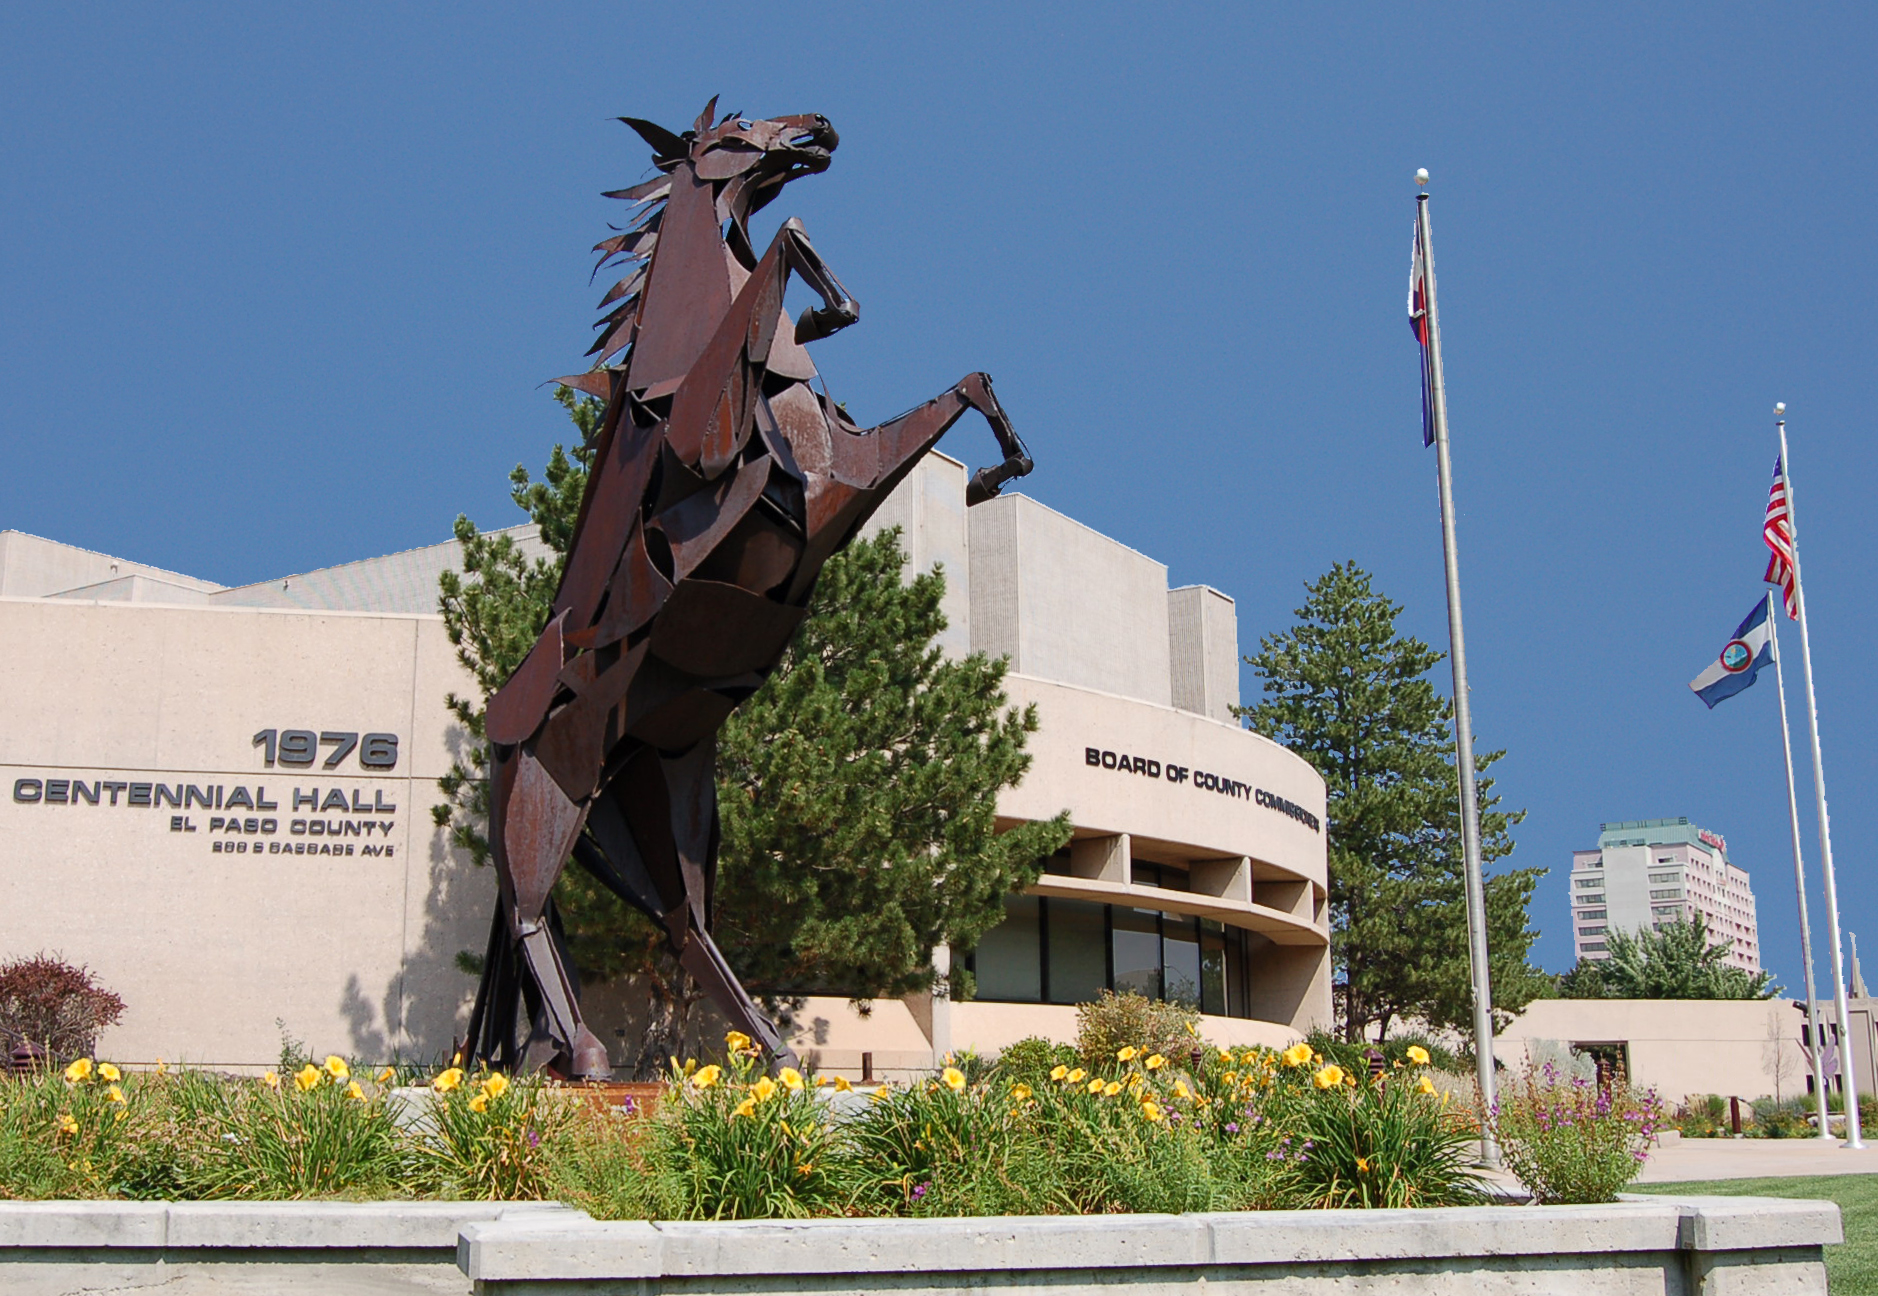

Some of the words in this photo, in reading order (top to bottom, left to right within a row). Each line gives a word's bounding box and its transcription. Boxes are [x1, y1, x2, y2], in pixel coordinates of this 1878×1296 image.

[252, 728, 399, 770] 1976
[1085, 747, 1161, 779] BOARD
[1166, 764, 1189, 784] OF
[1194, 770, 1252, 801] COUNTY
[13, 778, 278, 810] CENTENNIAL
[292, 787, 397, 813] HALL
[170, 816, 196, 833] EL
[209, 817, 278, 834] PASO
[290, 819, 395, 837] COUNTY
[361, 844, 395, 858] AVE
